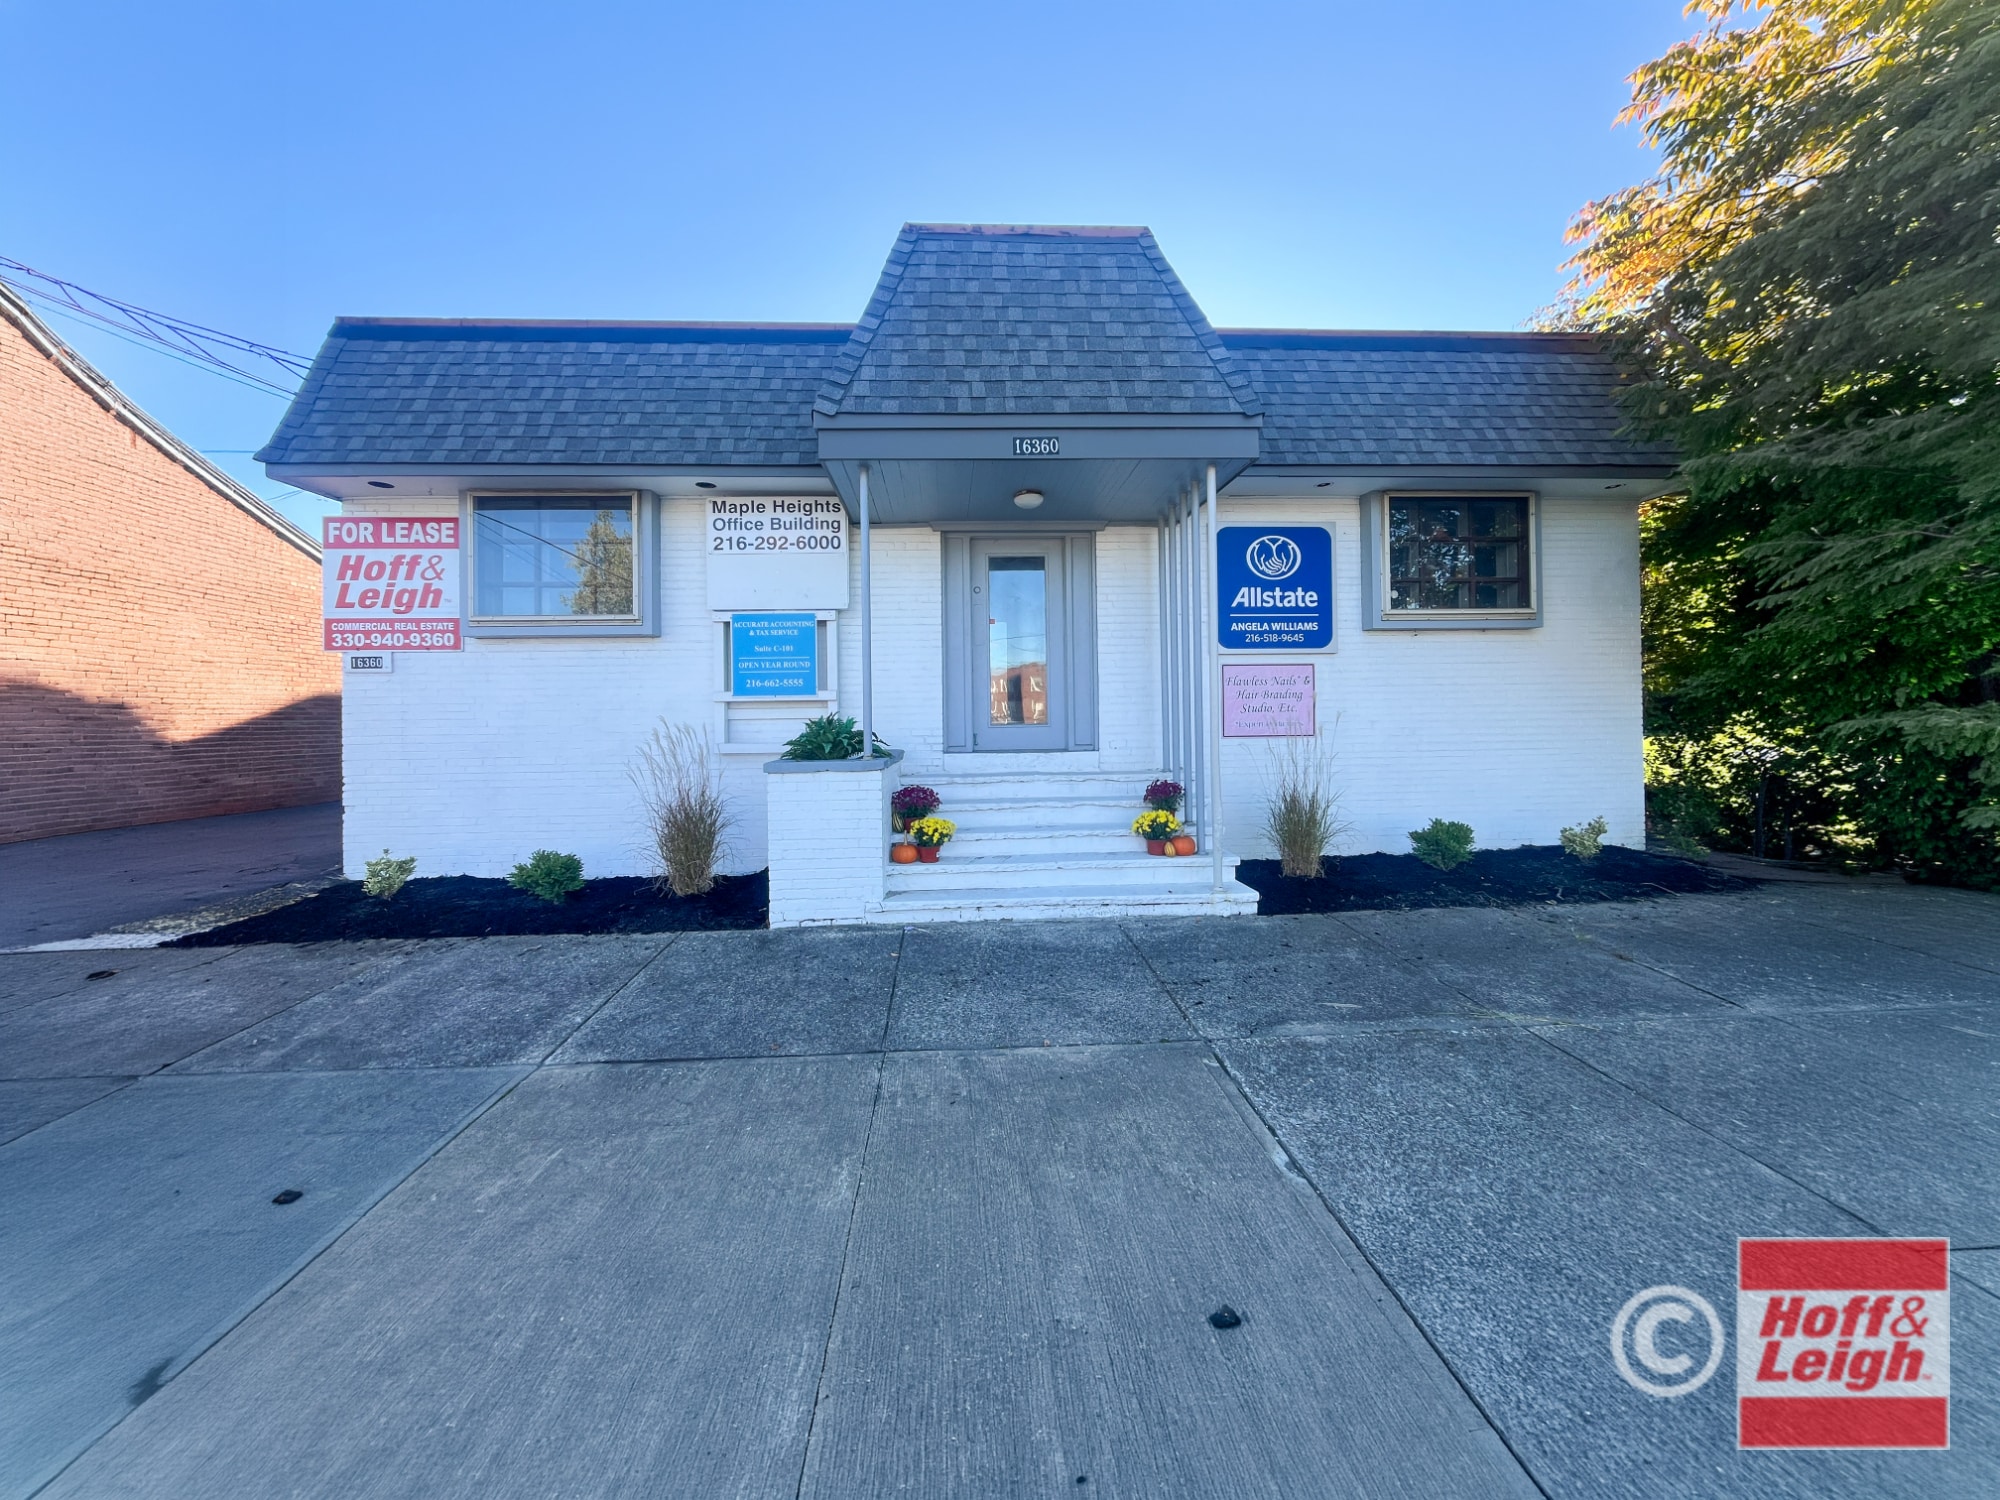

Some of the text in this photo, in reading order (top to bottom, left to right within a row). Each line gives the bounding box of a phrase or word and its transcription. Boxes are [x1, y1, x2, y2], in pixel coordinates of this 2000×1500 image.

[1016, 438, 1059, 454] 16360
[712, 500, 841, 516] Maple Heights
[713, 517, 840, 533] Office Building
[328, 522, 455, 544] FOR LEASE
[713, 535, 841, 550] 216-292-6000
[335, 582, 443, 614] Leigh
[1231, 586, 1318, 608] Allstate
[331, 622, 455, 631] COMMERCIAL REAL ESTATE
[1230, 622, 1319, 631] ANGELA WILLIAMS
[331, 633, 455, 647] 330-940-9360
[1245, 633, 1304, 643] 216-518-9645
[351, 657, 383, 668] 16360
[738, 661, 759, 669] OPEN
[746, 679, 804, 687] 216-662-5555
[1226, 675, 1268, 687] Flawless
[1303, 675, 1310, 685] &
[1235, 688, 1303, 702] Hair Braiding
[1239, 702, 1275, 714] Studio,
